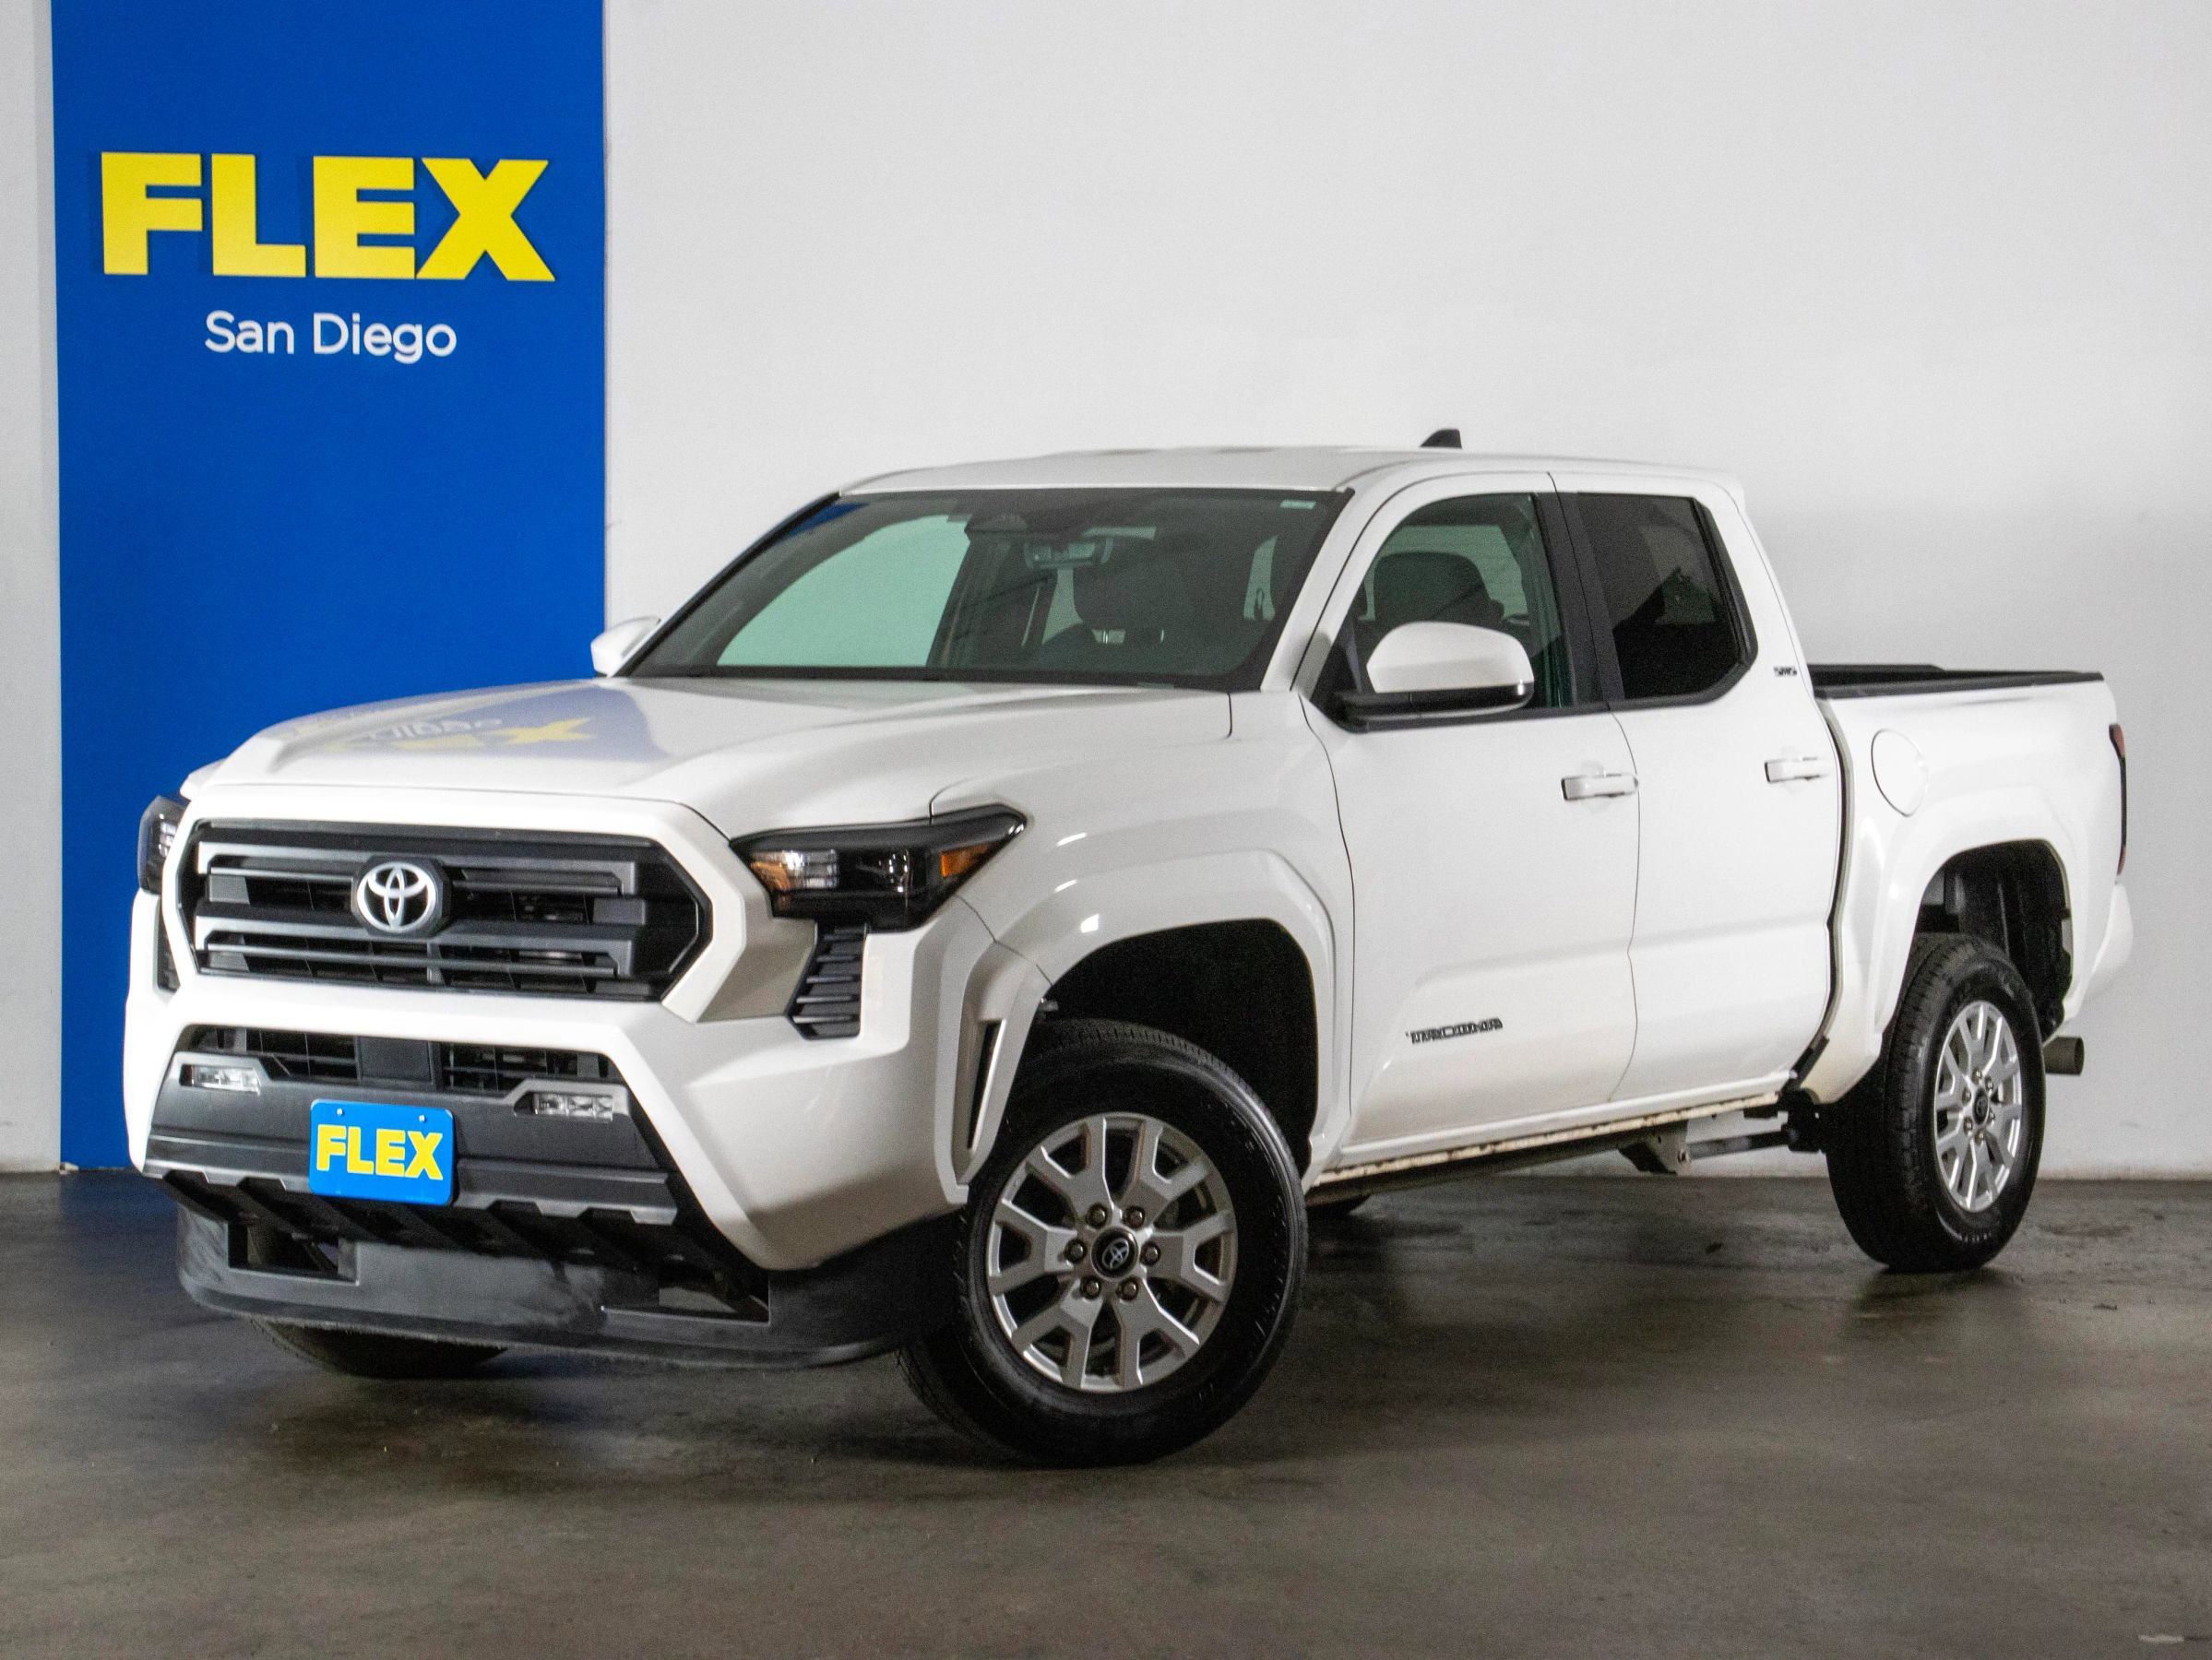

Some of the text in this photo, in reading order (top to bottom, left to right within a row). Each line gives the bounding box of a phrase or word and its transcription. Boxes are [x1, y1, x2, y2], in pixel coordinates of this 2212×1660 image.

[101, 151, 555, 282] FLEX
[205, 310, 458, 365] San Diego
[315, 1123, 444, 1181] FLEX
